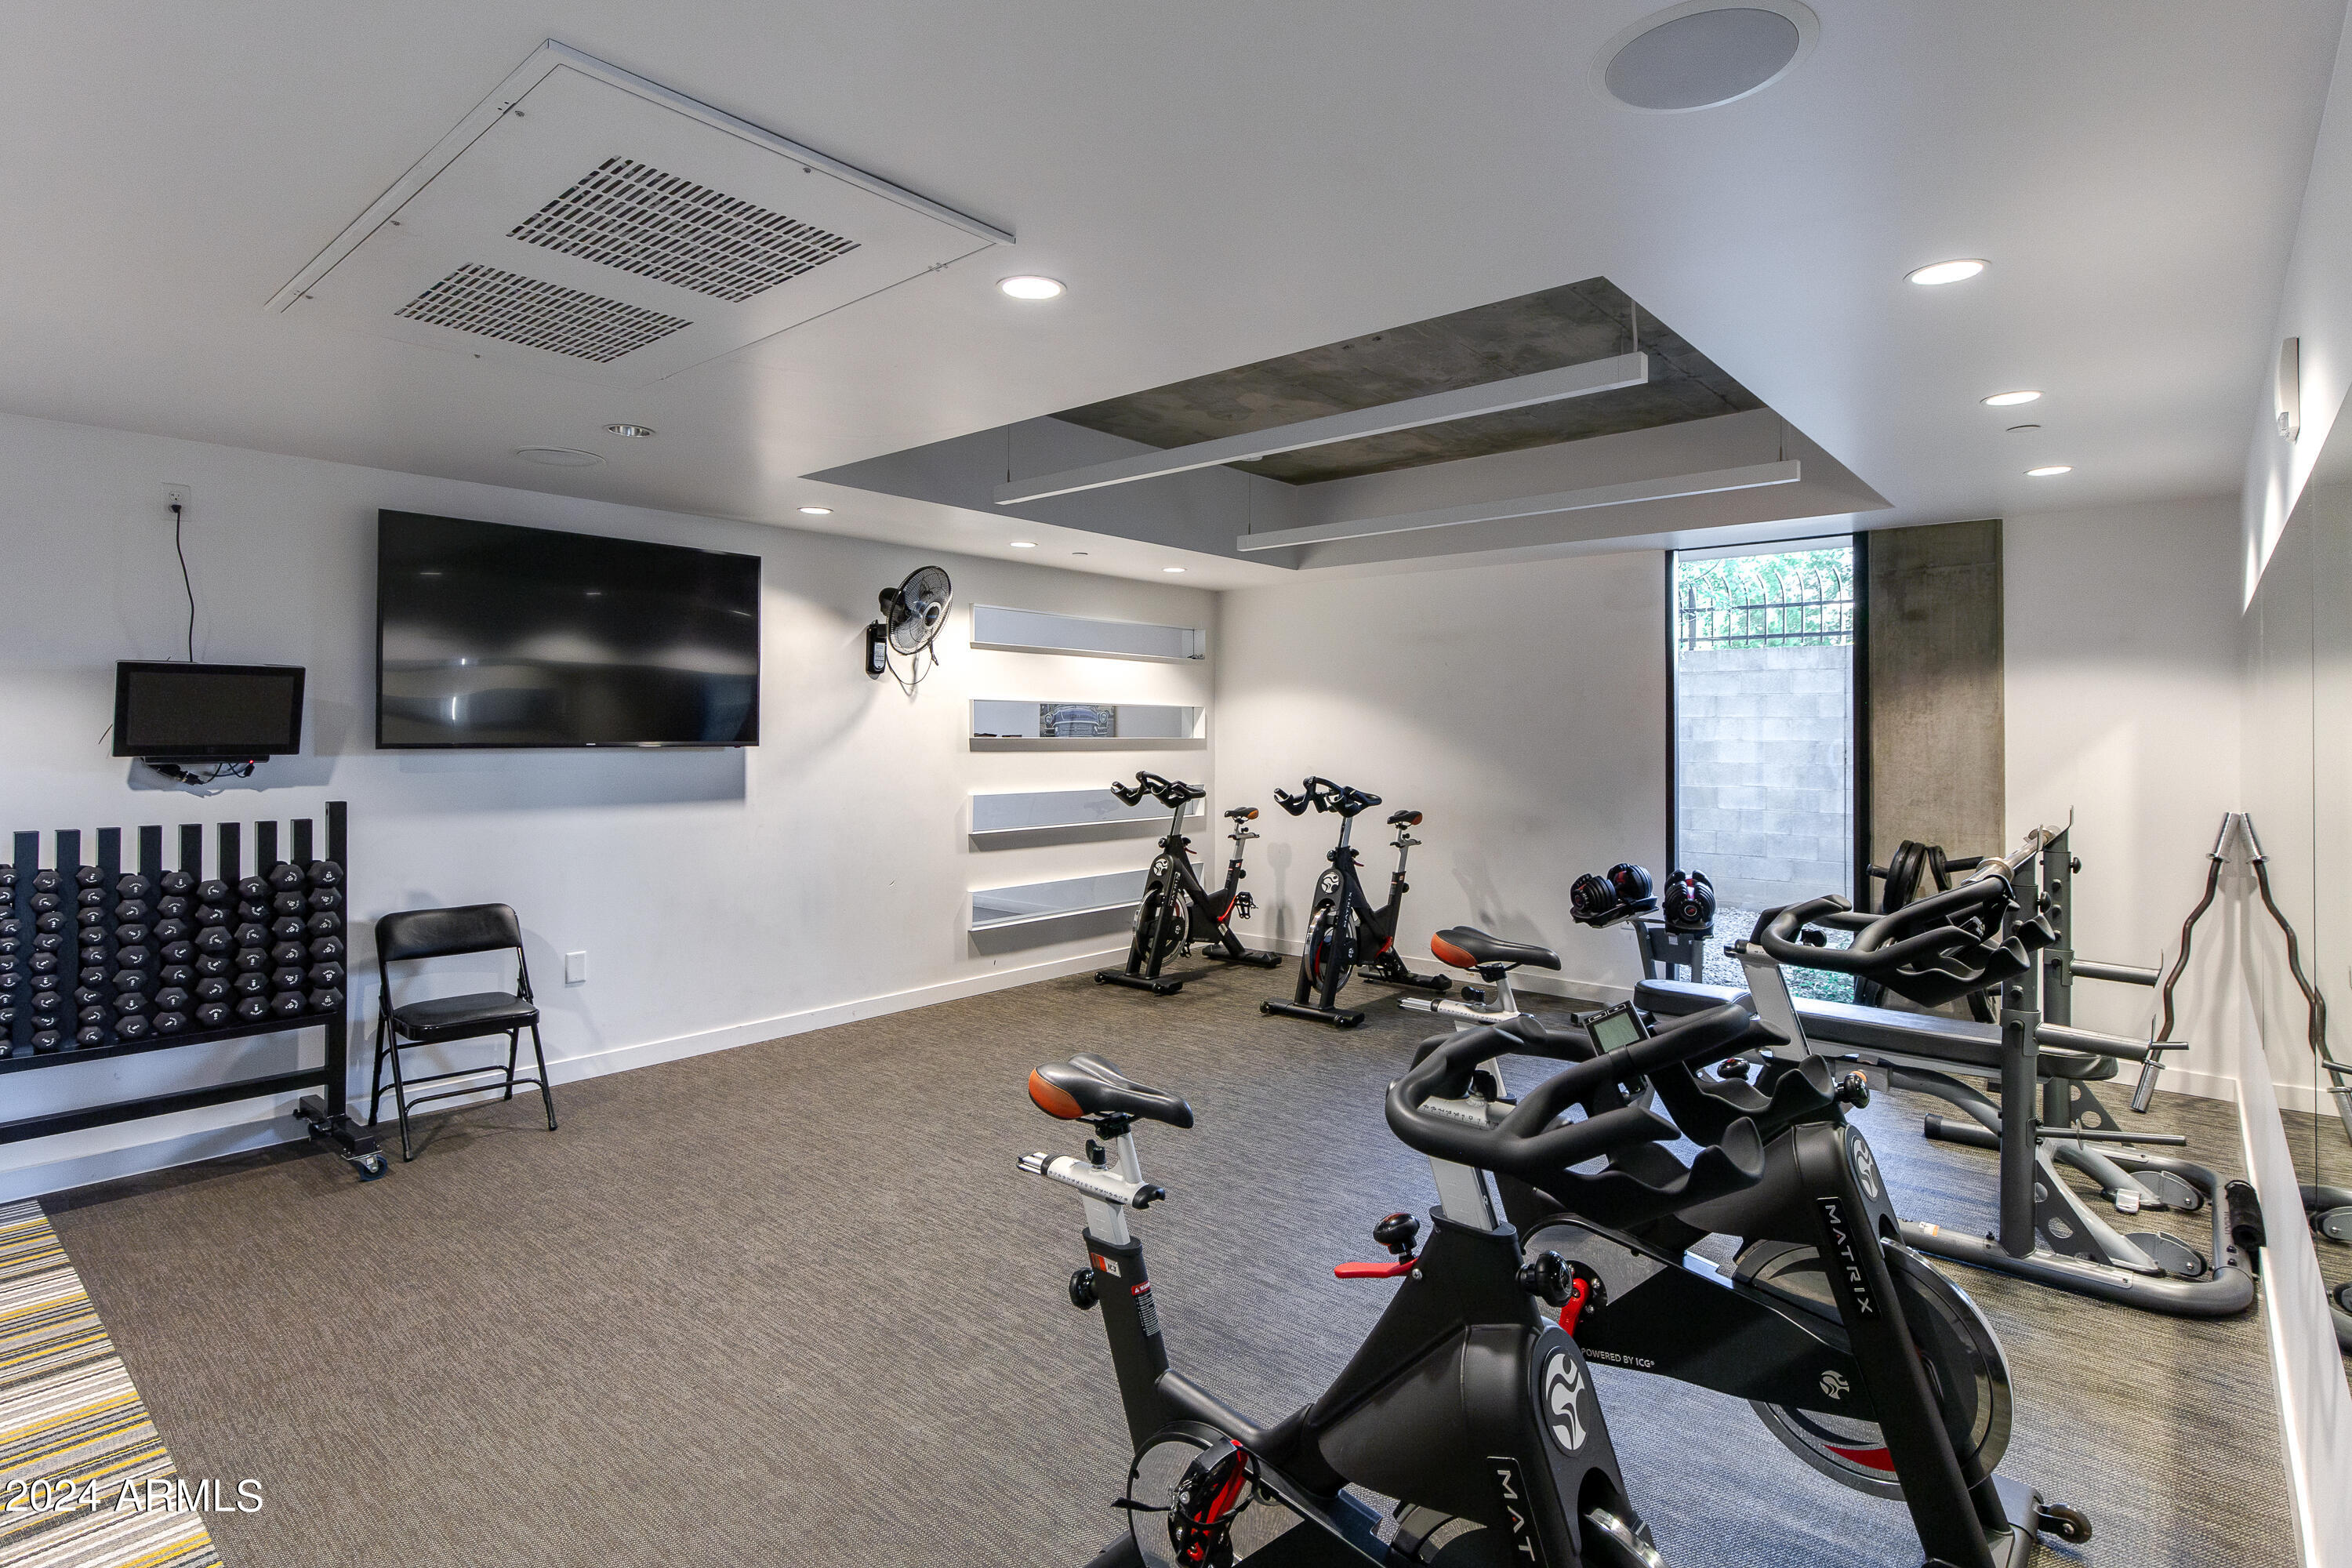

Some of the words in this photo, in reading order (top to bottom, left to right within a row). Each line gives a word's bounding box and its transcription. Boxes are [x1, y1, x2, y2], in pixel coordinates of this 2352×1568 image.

[1825, 1204, 1873, 1313] MATRIX
[1581, 1348, 1621, 1362] POWERED
[1623, 1355, 1634, 1364] BY
